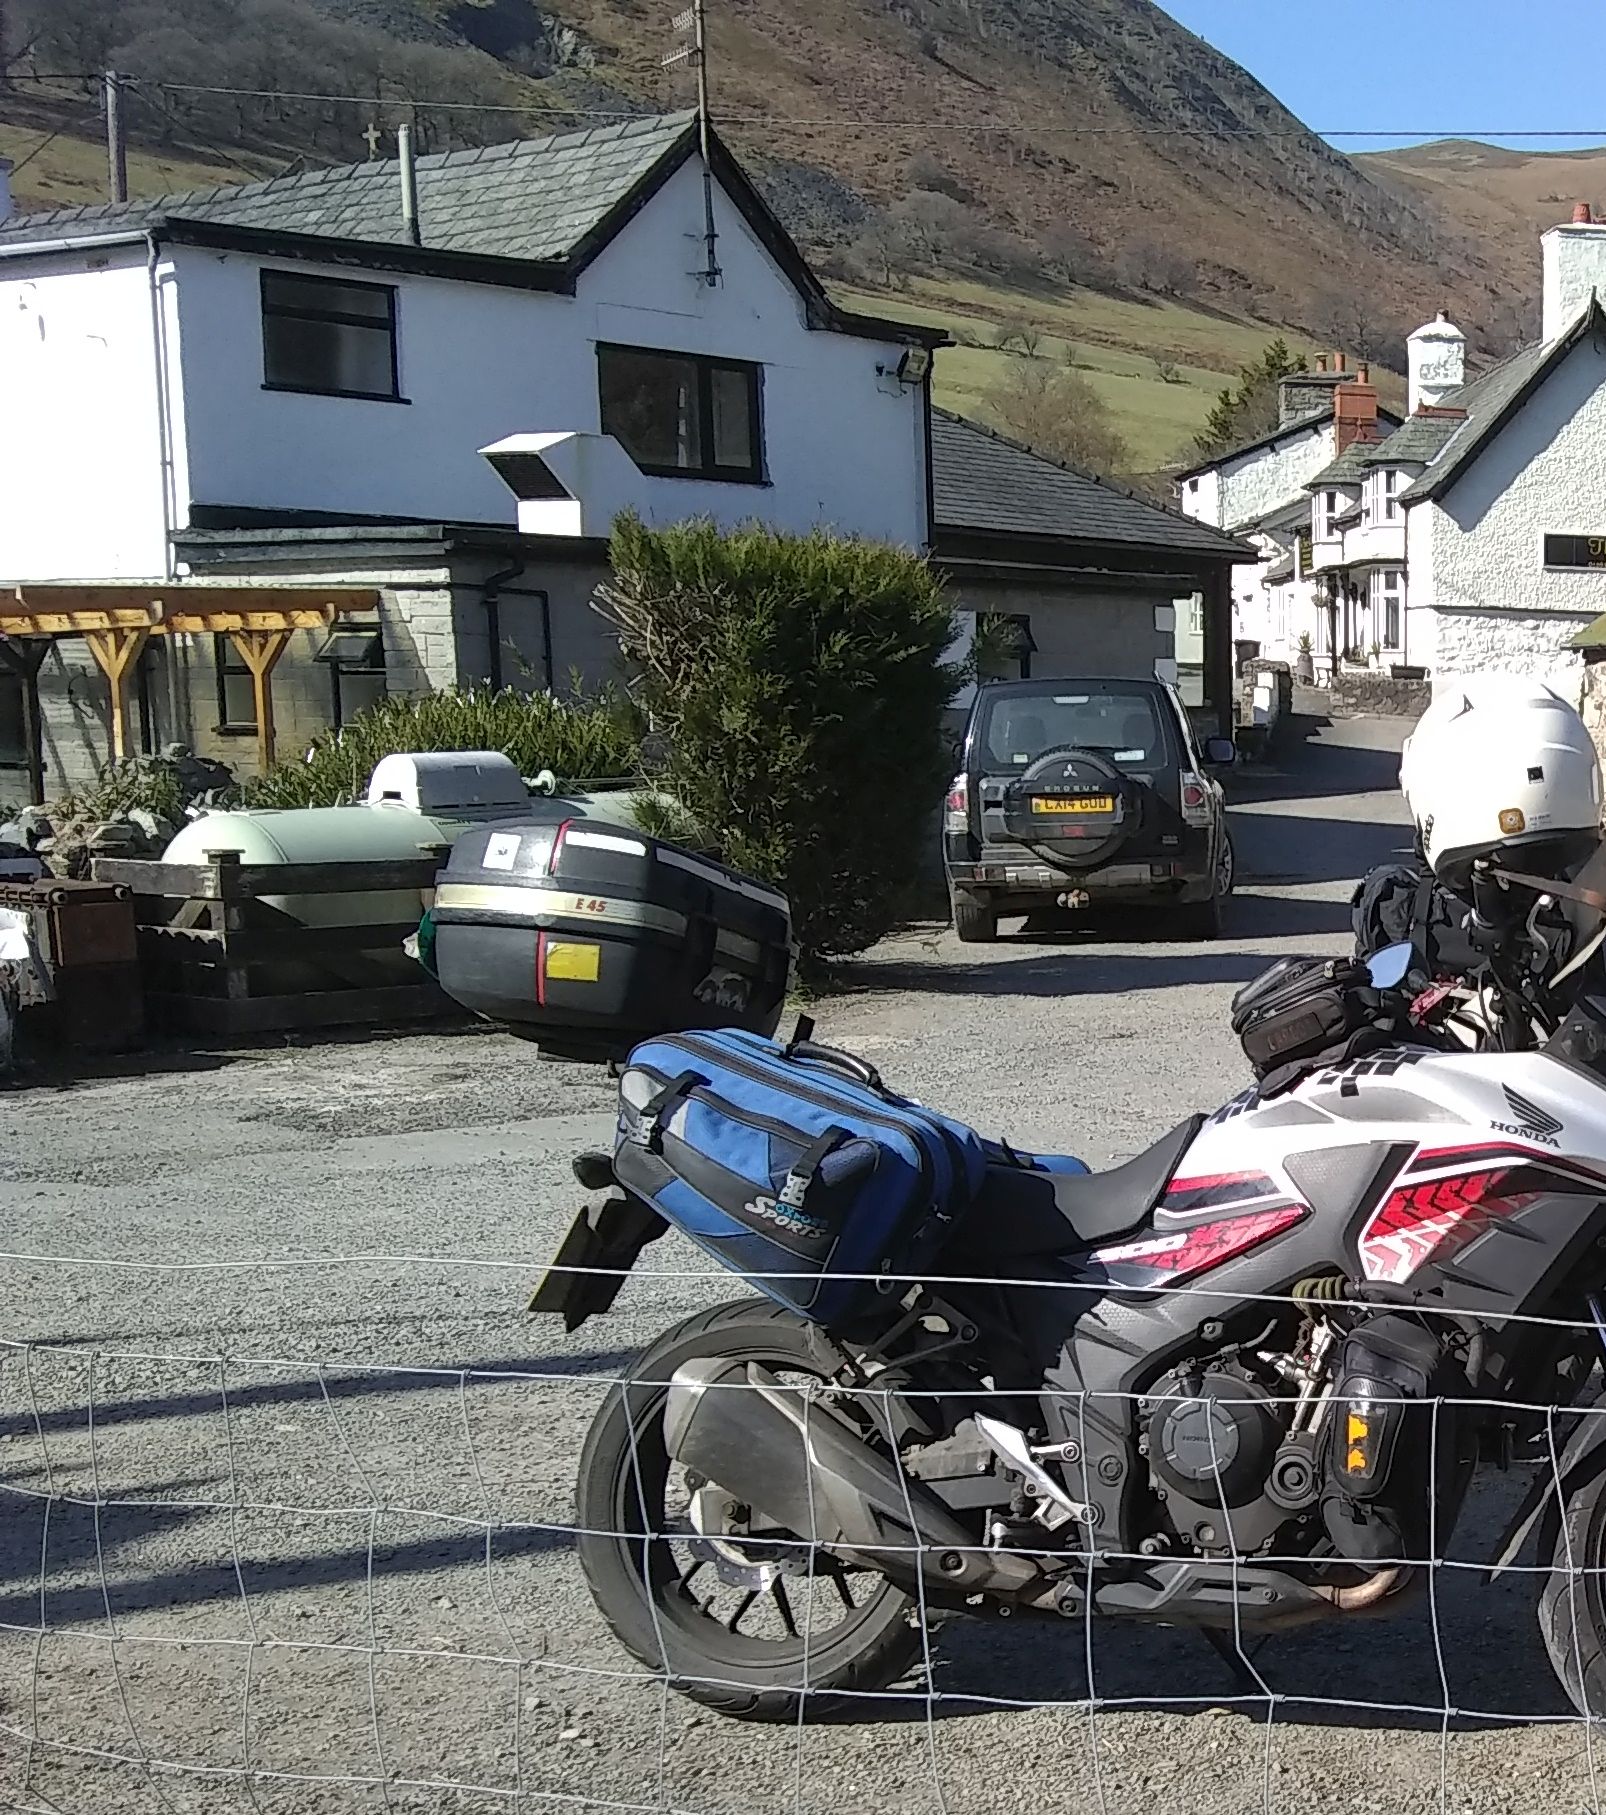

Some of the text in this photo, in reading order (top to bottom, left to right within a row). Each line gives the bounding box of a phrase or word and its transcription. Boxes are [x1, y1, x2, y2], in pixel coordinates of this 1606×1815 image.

[575, 897, 609, 913] E 45
[1489, 1119, 1562, 1149] HONDA
[744, 1196, 827, 1239] SPORTS
